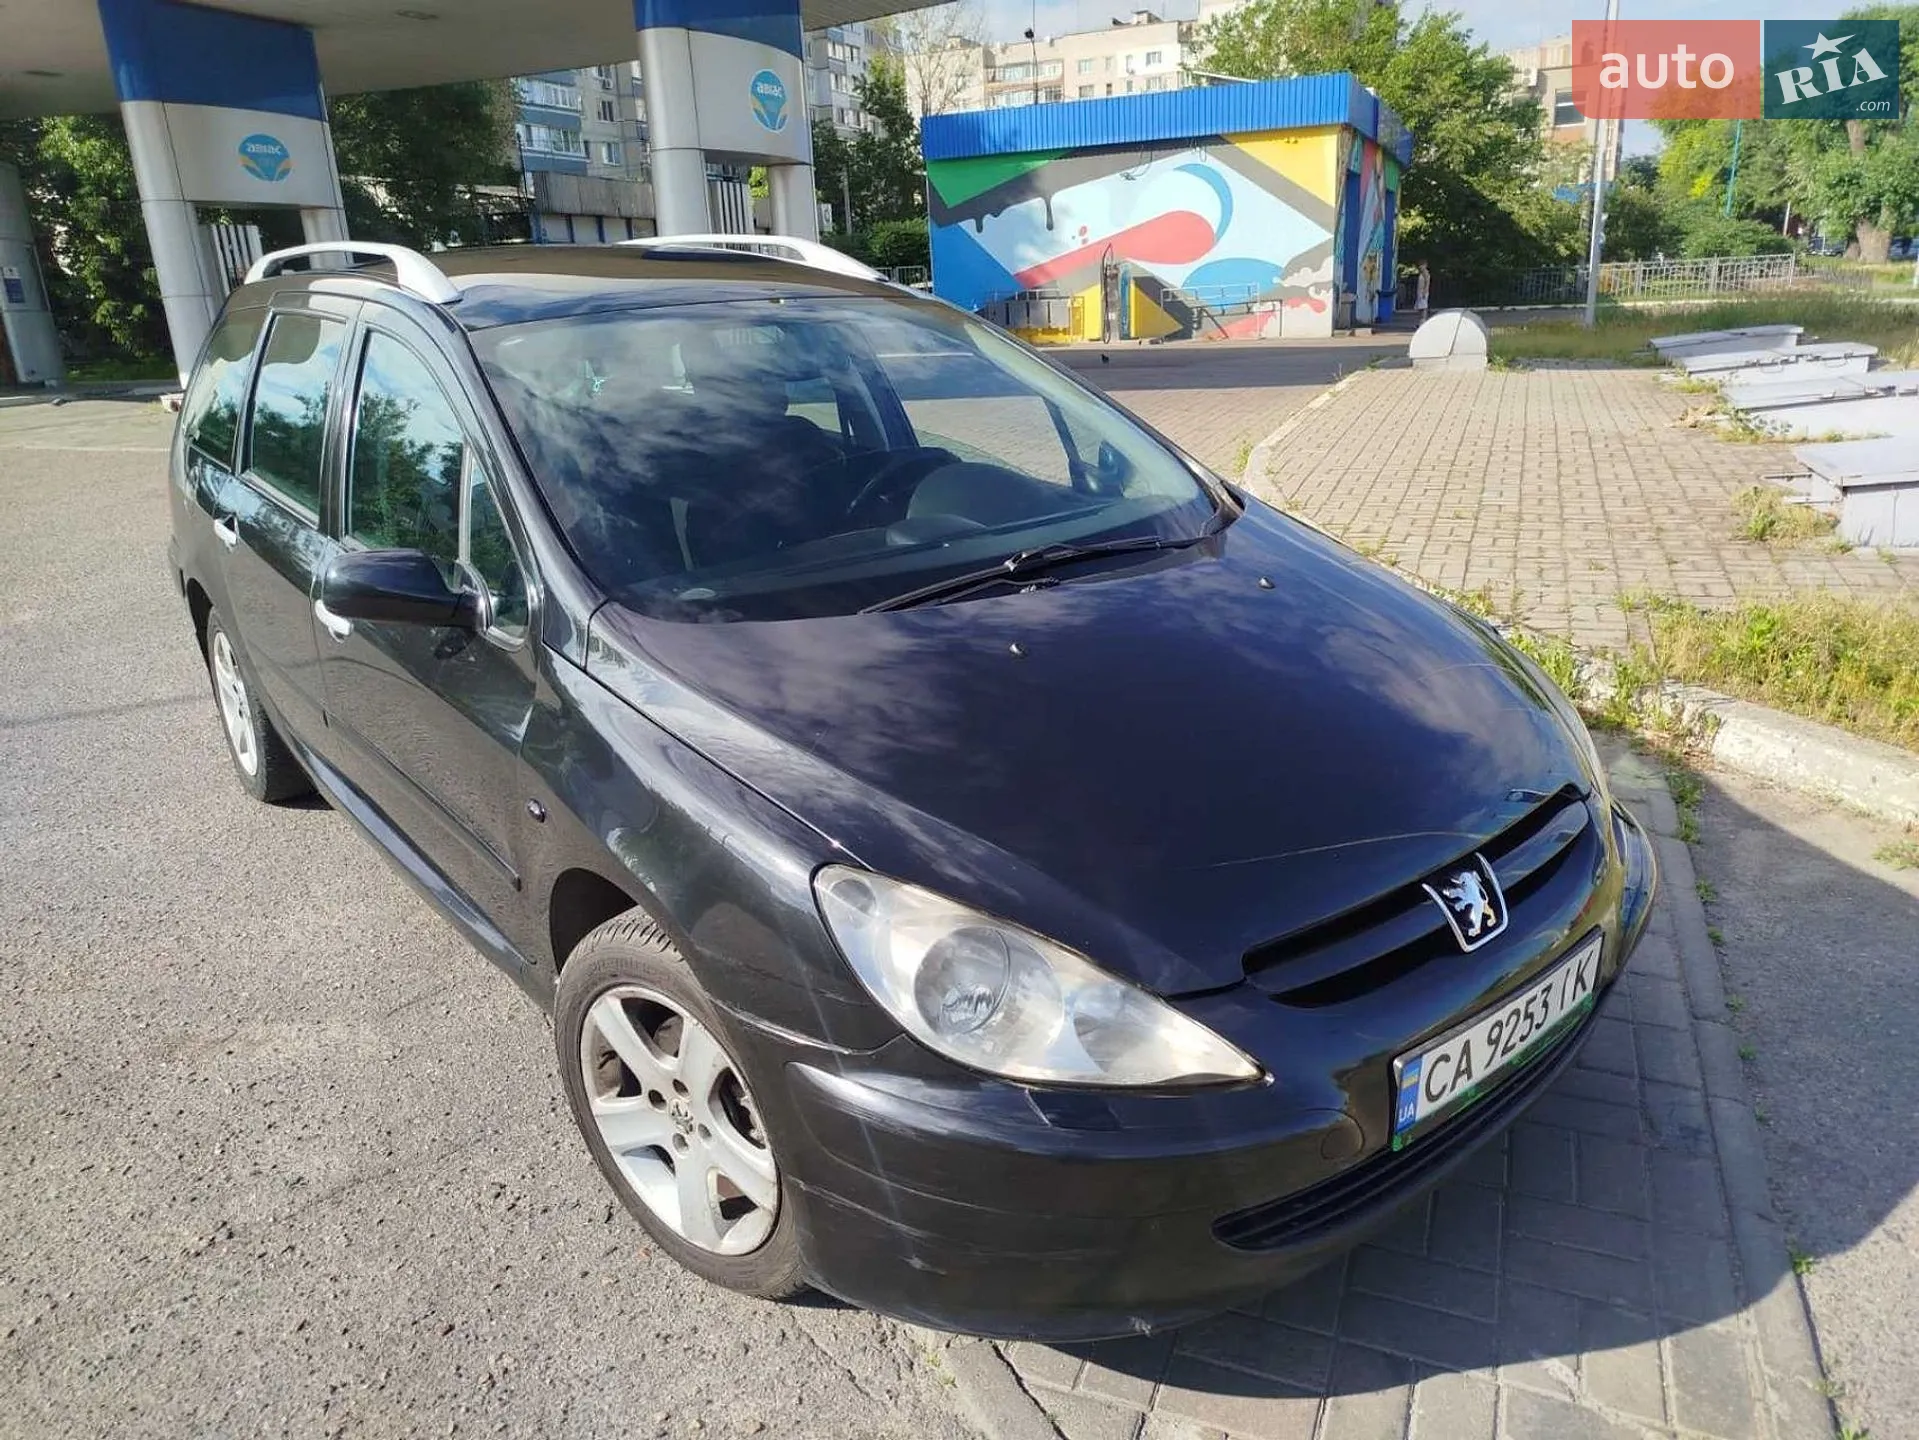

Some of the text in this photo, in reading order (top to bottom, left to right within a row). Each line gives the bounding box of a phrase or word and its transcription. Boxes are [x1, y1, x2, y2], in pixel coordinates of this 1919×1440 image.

[1425, 950, 1594, 1102] CA 9253 IK
[1399, 1101, 1414, 1121] UA
